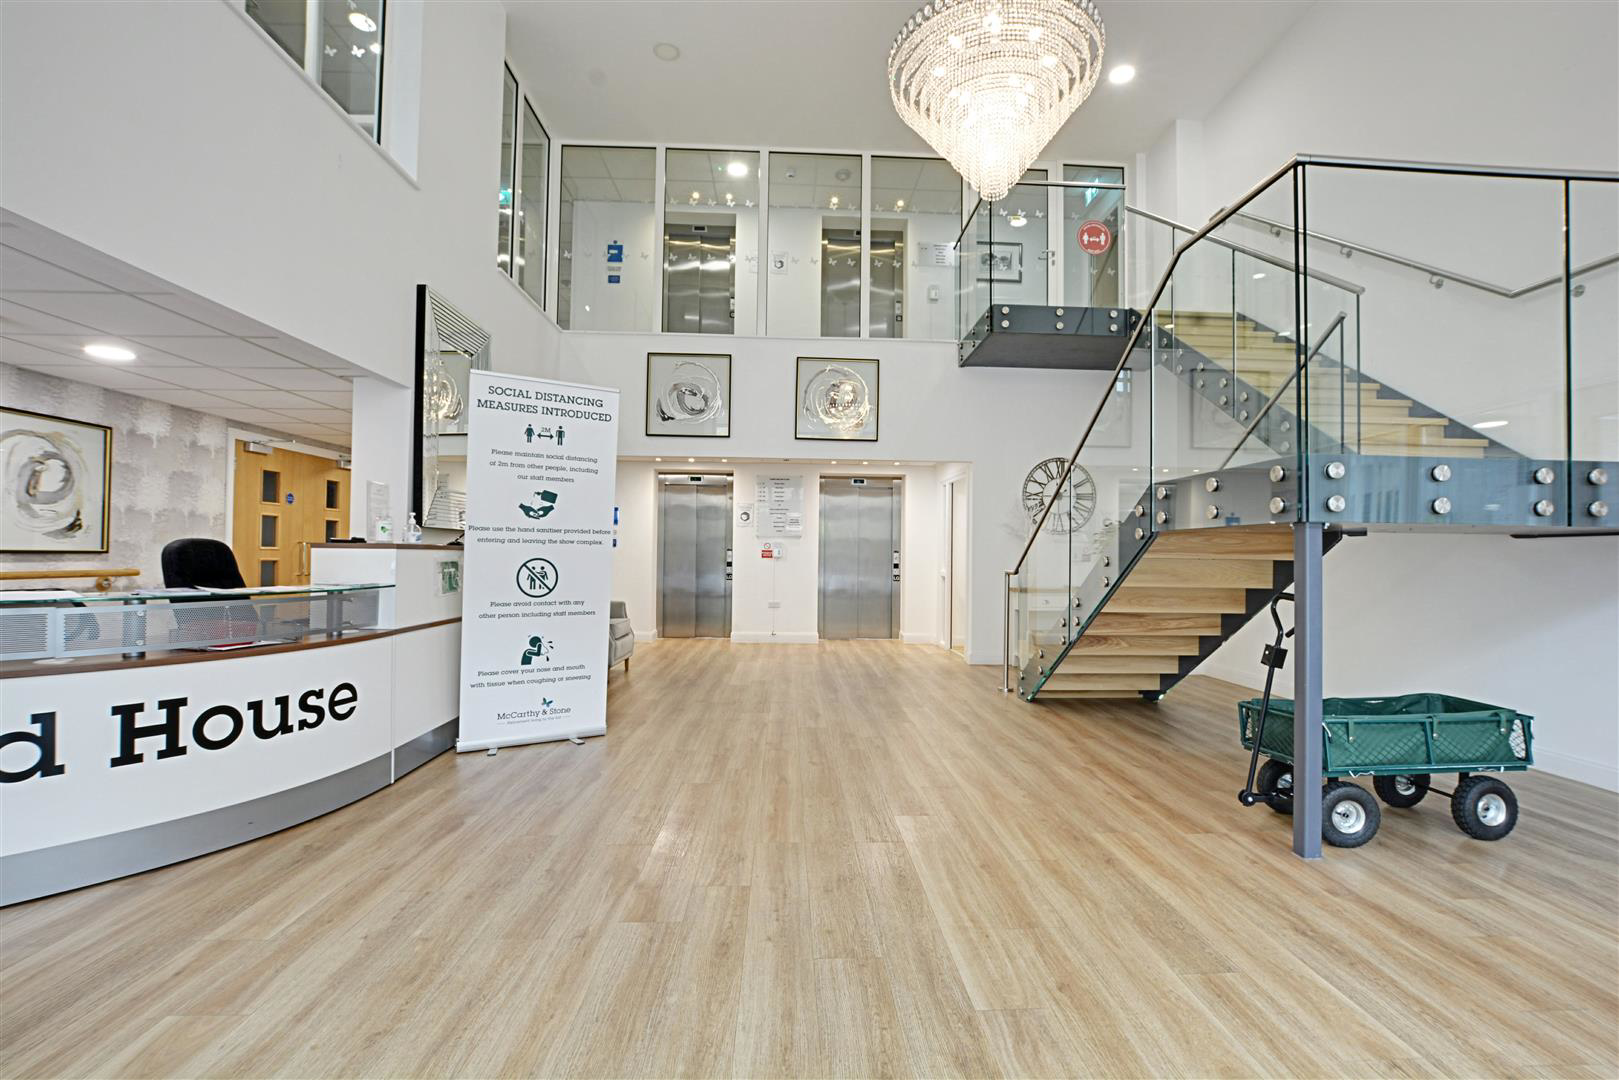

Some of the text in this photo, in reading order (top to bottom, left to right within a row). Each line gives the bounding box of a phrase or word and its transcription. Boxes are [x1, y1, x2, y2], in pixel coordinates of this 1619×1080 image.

[488, 386, 604, 408] SOCIAL DISTANCING
[477, 399, 612, 422] MEASURES INTRODUCED
[515, 450, 544, 459] maintain
[566, 455, 598, 464] distancing
[110, 682, 358, 768] House
[497, 710, 540, 720] McCarthy
